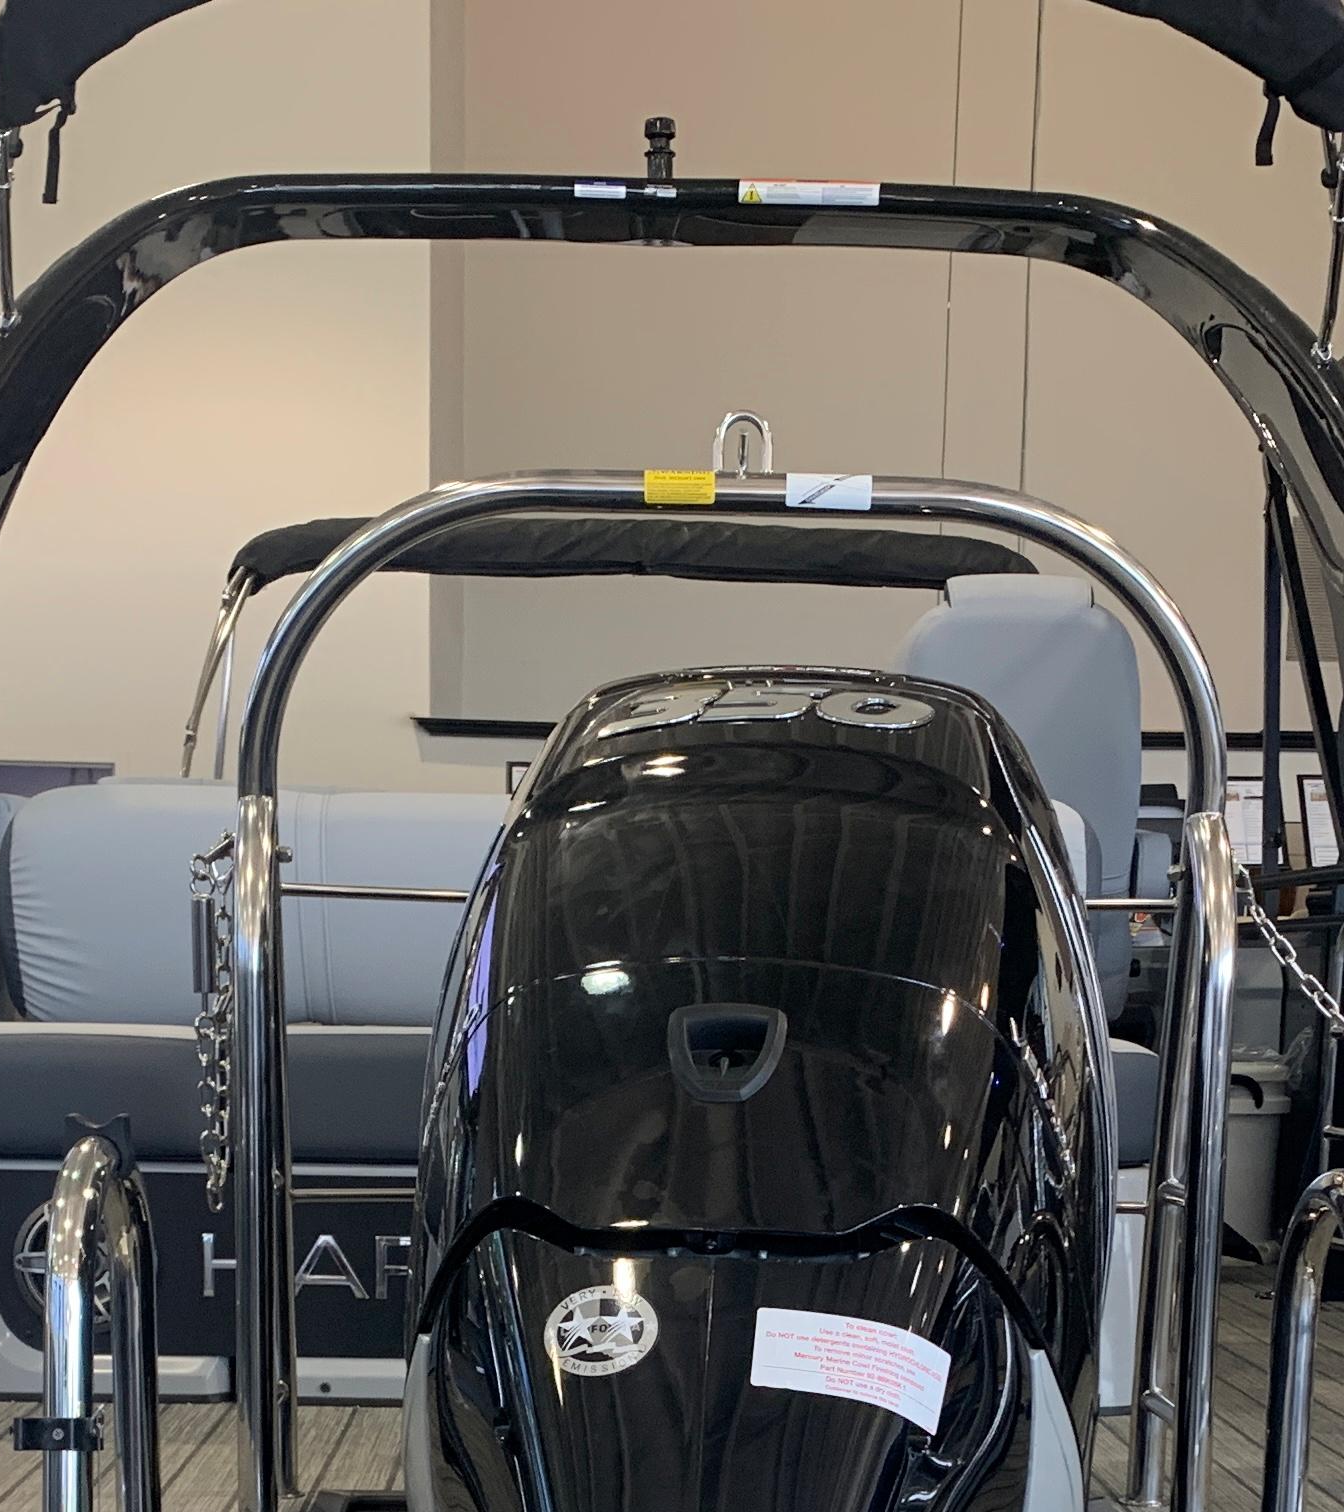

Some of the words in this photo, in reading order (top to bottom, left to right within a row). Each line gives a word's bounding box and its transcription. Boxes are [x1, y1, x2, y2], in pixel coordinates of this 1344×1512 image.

[597, 680, 937, 731] 350
[561, 1288, 596, 1311] VERY
[838, 1377, 854, 1386] NOT
